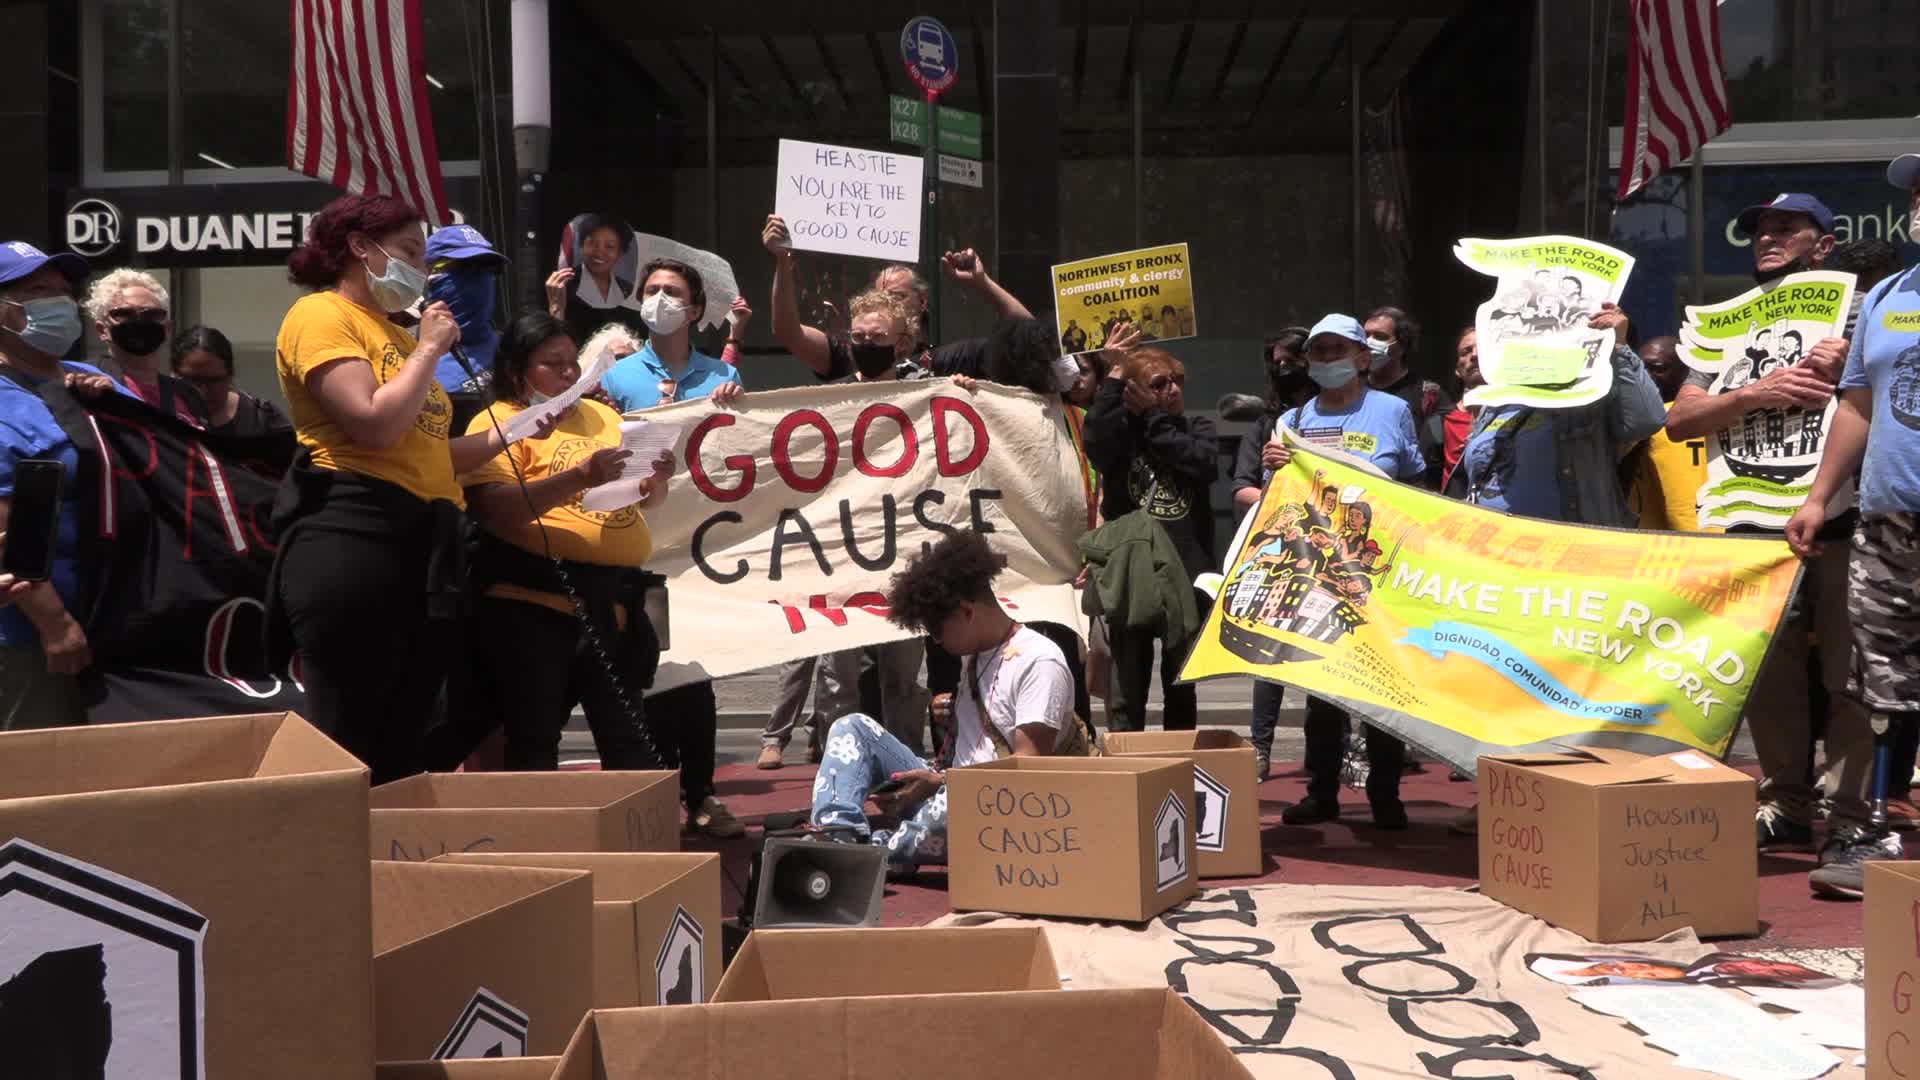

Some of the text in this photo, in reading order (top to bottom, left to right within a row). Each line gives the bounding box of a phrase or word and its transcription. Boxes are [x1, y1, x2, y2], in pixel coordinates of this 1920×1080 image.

[894, 99, 919, 116] X27
[894, 122, 920, 141] X28
[815, 148, 897, 176] HEASTIE
[790, 174, 906, 201] YOU ARE THE
[826, 202, 887, 220] KEY TO
[136, 211, 293, 252] DUANE
[793, 219, 911, 247] GOOD CAUSE
[1058, 252, 1183, 283] NORTHWEST BRONX
[1484, 246, 1619, 269] MAKE THE ROAD
[1545, 256, 1614, 277] NEW YORK
[1060, 267, 1185, 297] community & clergy
[1083, 284, 1160, 307] COALITION
[1708, 287, 1839, 329] MAKE THE ROAD
[1765, 303, 1834, 321] NEW YORK
[684, 396, 990, 502] GOOD
[1347, 434, 1374, 446] ROAD
[1392, 562, 1746, 687] MAKE THE ROAD
[1321, 663, 1406, 707] WESTCHESTER
[1434, 631, 1501, 662] DIGNIDAD,
[1504, 657, 1581, 711] COMUNIDAD
[1595, 705, 1643, 720] PODER
[1551, 626, 1725, 719] NEW YORK
[976, 784, 1071, 819] GOOD
[1488, 766, 1545, 812] PASS
[1491, 817, 1544, 855] GOOD
[1626, 803, 1719, 842] Housing
[978, 826, 1081, 855] CAUSE
[1622, 838, 1707, 867] Justice
[1491, 853, 1552, 889] CAUSE
[1653, 871, 1668, 893] 4
[1641, 897, 1688, 926] ALL
